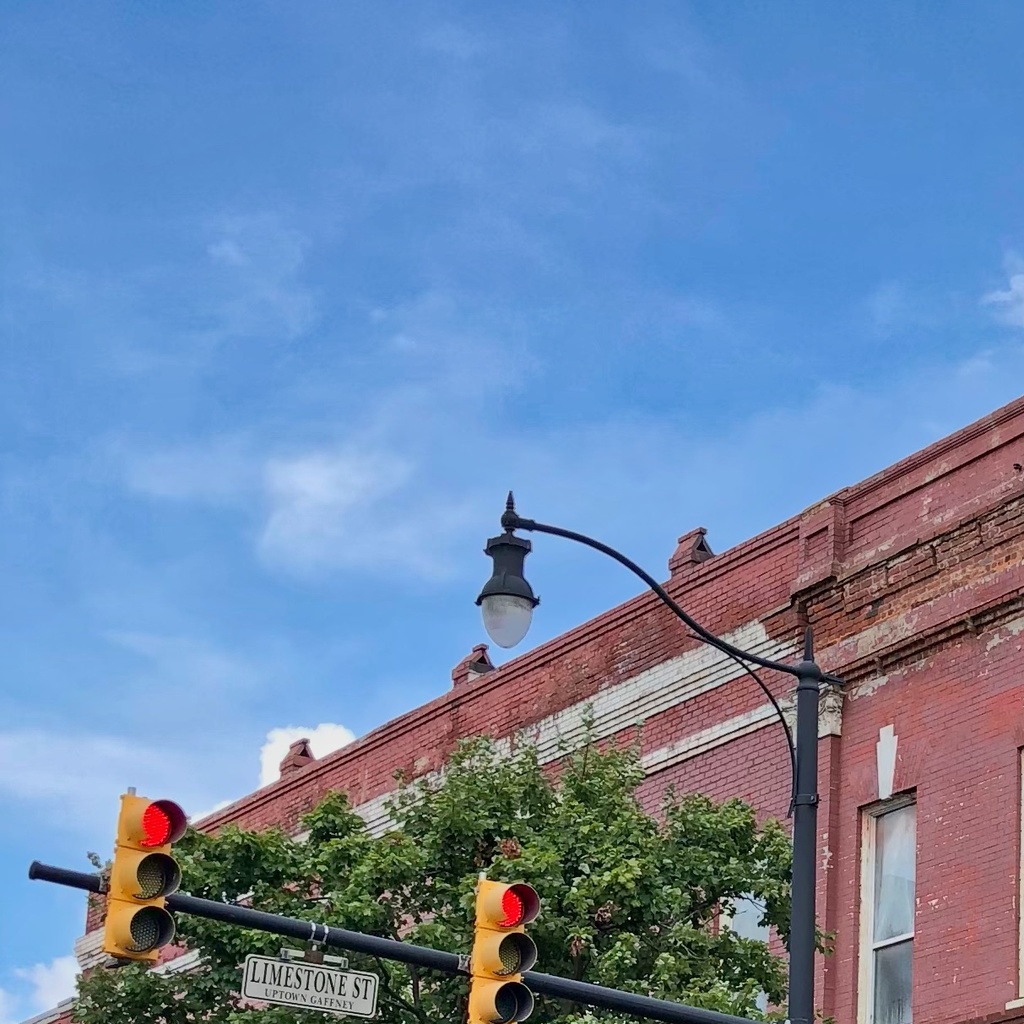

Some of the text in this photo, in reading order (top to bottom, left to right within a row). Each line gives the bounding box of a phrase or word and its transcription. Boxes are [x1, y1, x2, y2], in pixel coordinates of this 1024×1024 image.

[250, 960, 372, 1000] LIMESTONE ST
[264, 988, 354, 1010] UPTOWN GAFFNEY
